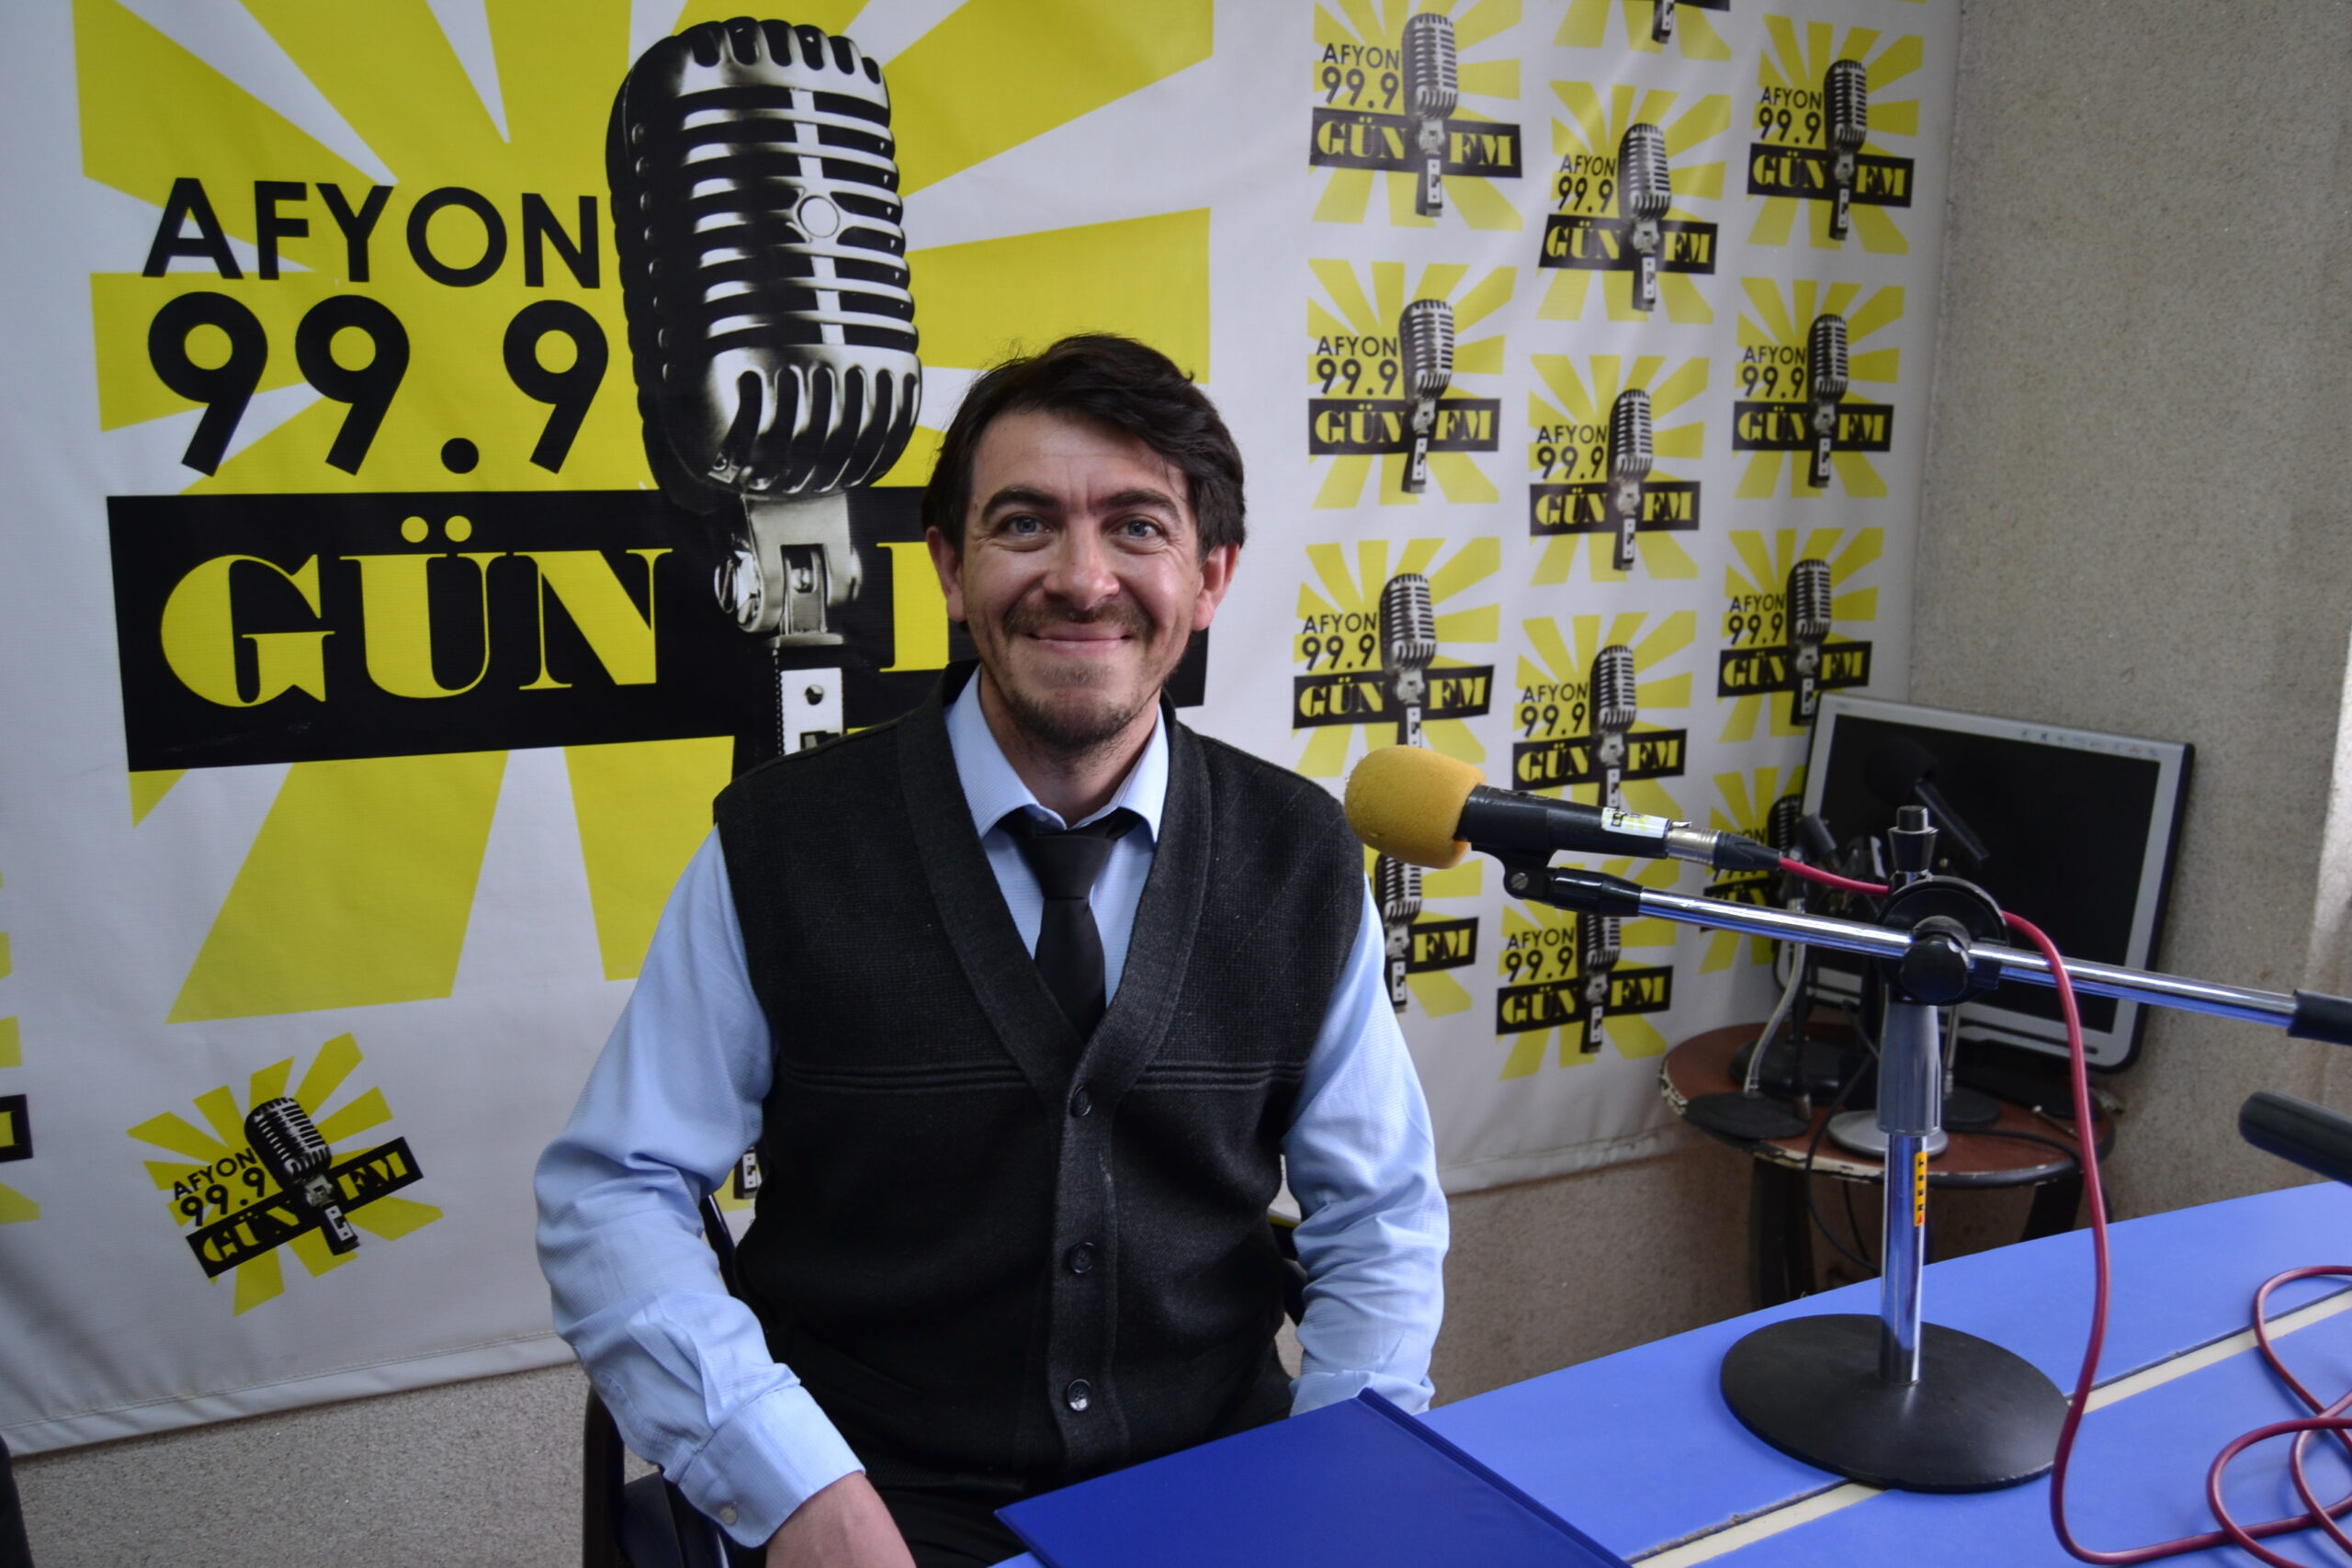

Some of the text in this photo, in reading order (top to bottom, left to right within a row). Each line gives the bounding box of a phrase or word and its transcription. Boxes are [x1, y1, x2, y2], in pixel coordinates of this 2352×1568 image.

[1322, 42, 1399, 71] AFYON
[1322, 69, 1399, 108] 99.9
[1760, 86, 1821, 109] AFYON
[1317, 117, 1514, 166] GÜN FM
[1759, 107, 1820, 145] 99.9
[1559, 153, 1616, 177] AFYON
[1753, 152, 1906, 197] GÜN FM
[1558, 176, 1614, 213] 99.9
[142, 177, 600, 289] AFYON
[1546, 220, 1710, 263] GÜN FM
[1317, 336, 1397, 357] AFYON
[1743, 346, 1805, 364] AFYON
[148, 290, 608, 477] 99.9
[1317, 358, 1398, 395] 99.9
[1742, 366, 1804, 399] 99.9
[1315, 404, 1493, 445] GÜN FM
[1536, 425, 1607, 444] AFYON
[1737, 407, 1890, 443] GÜN FM
[1536, 446, 1603, 479] 99.9
[1535, 490, 1693, 527] GÜN FM
[160, 514, 673, 707] GÜN
[1729, 594, 1784, 613] AFYON
[1302, 612, 1376, 633] AFYON
[1728, 613, 1783, 645] 99.9
[1303, 634, 1375, 671] 99.9
[1724, 649, 1862, 690] GÜN FM
[1300, 677, 1487, 717] GÜN FM
[1521, 682, 1587, 703] AFYON
[1521, 703, 1586, 738] 99.9
[1518, 739, 1679, 783] GÜN FM
[1413, 929, 1470, 962] FM
[1506, 927, 1575, 951] AFYON
[1506, 947, 1574, 982] 99.9
[1501, 976, 1668, 1024] GÜN FM
[174, 1148, 256, 1200] AFYON
[337, 1151, 408, 1201] FM
[180, 1168, 265, 1226] 99.9
